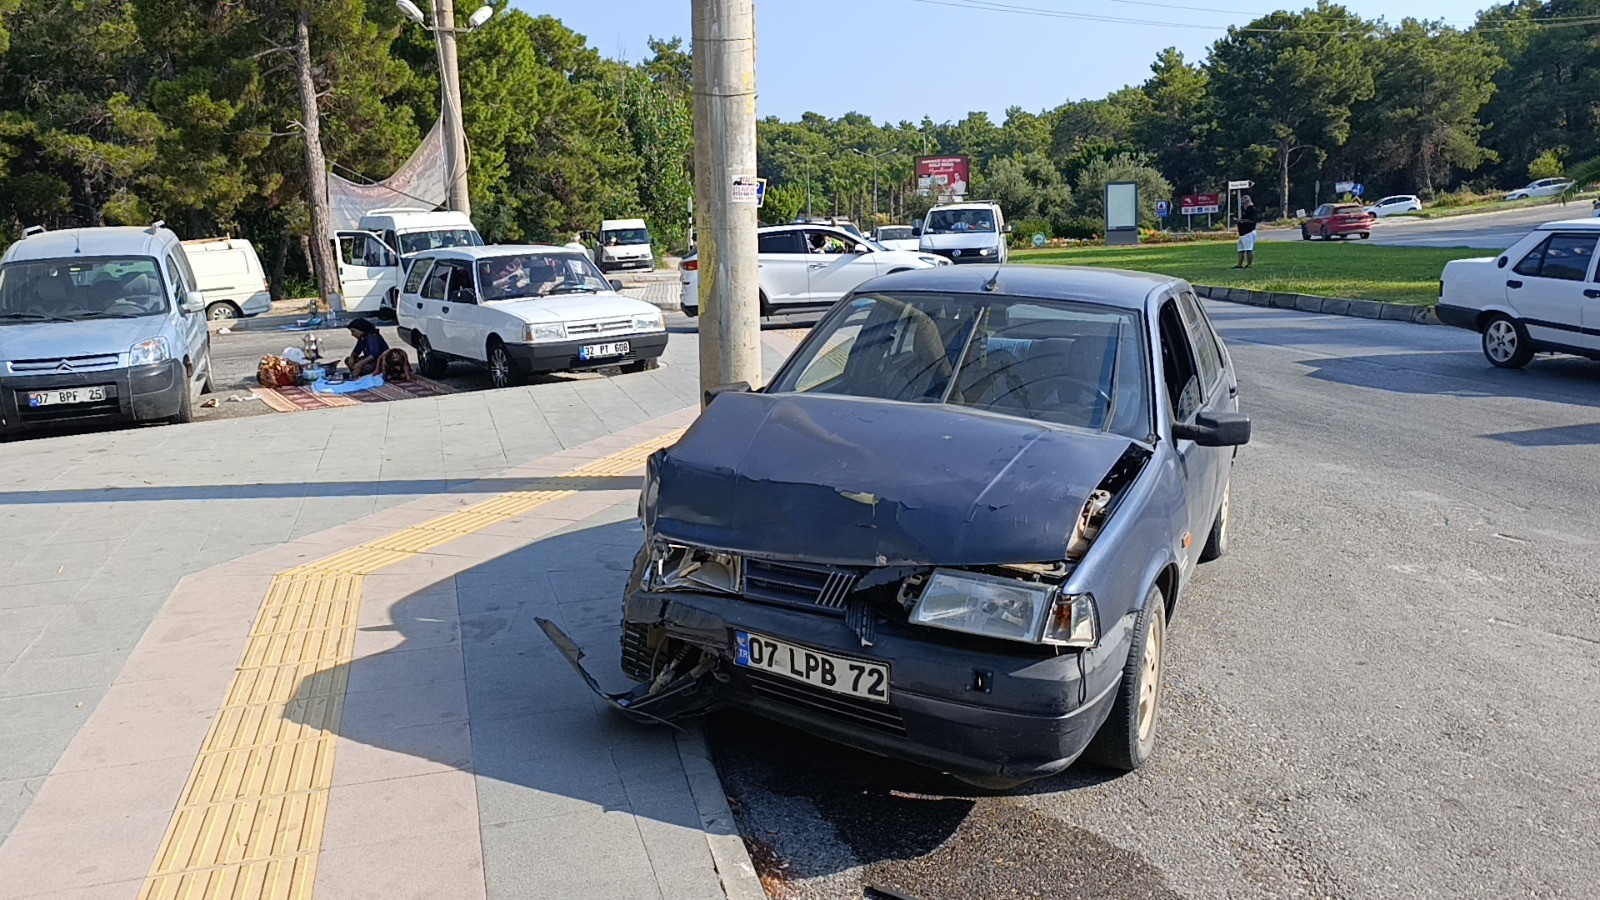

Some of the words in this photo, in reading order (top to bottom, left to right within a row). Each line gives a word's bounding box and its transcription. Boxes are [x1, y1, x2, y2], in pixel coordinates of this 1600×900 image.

[585, 346, 594, 356] 32
[600, 345, 608, 354] PT
[615, 343, 628, 352] 608
[36, 393, 49, 404] 07
[59, 391, 78, 402] BPF
[88, 389, 102, 400] 25
[738, 648, 749, 658] TR
[749, 637, 778, 668] 07
[788, 647, 837, 686] LPB
[849, 663, 885, 697] 72
